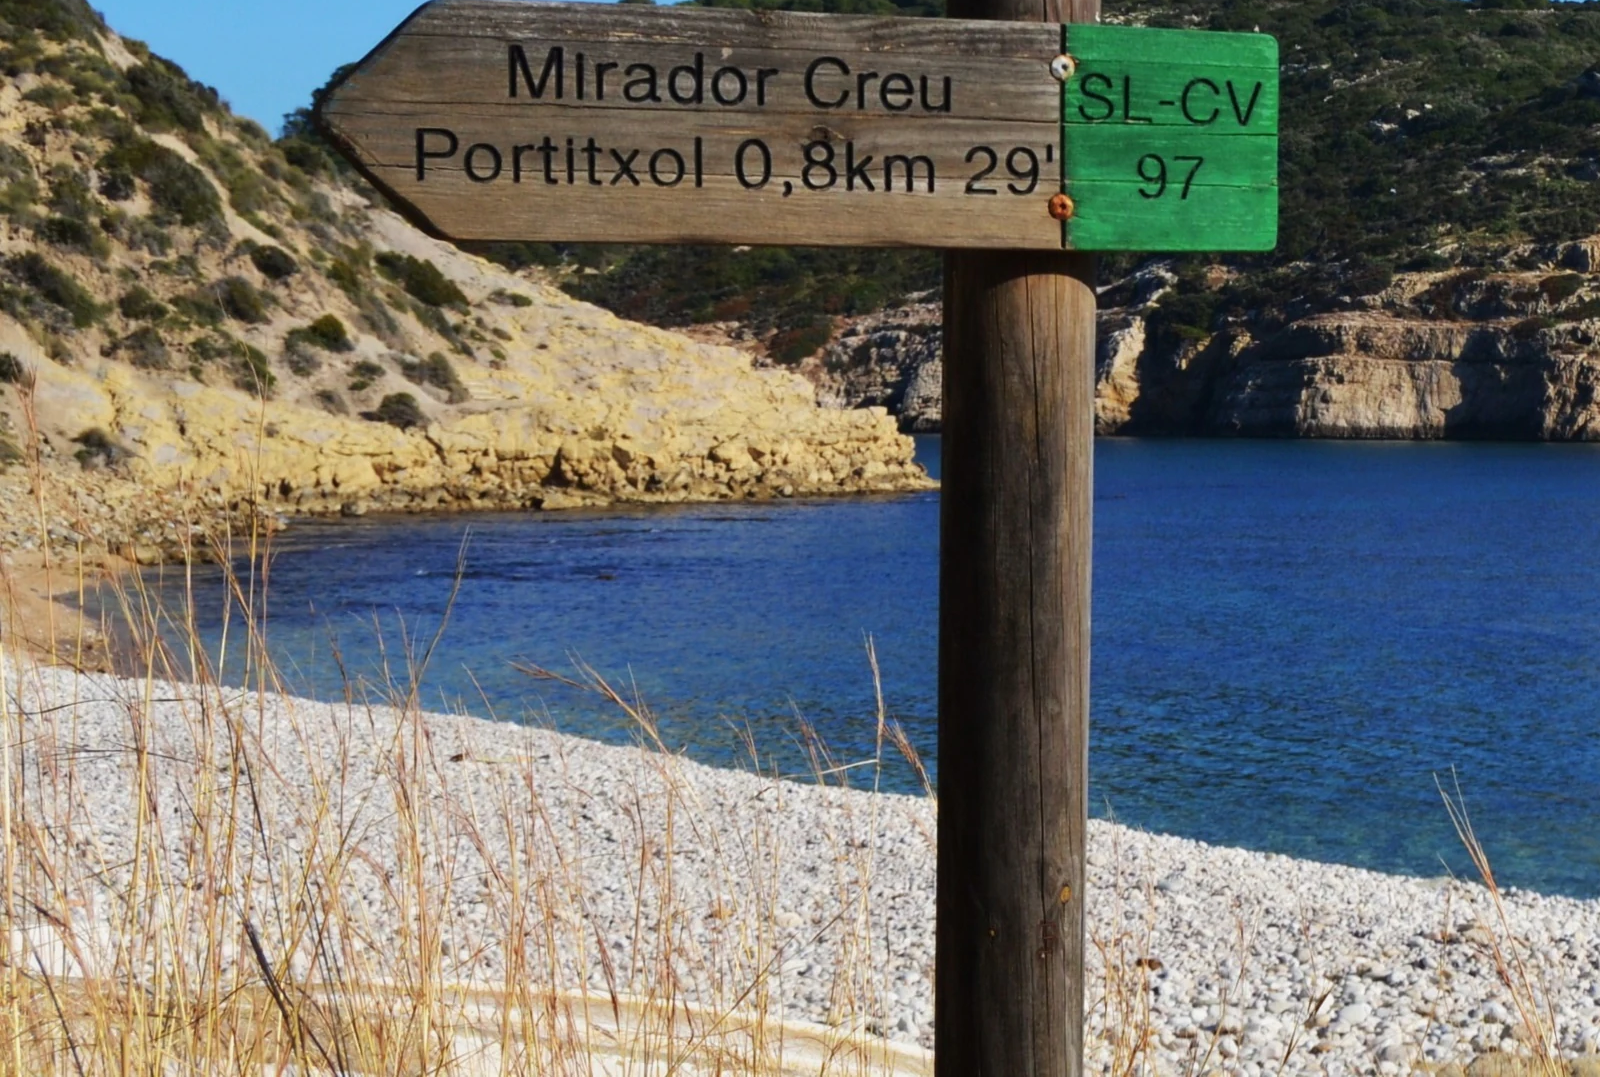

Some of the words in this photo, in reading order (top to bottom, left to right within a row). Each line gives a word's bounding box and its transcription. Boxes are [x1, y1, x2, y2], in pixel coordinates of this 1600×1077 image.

[506, 43, 778, 107] Mirador
[803, 56, 953, 114] Creu
[1077, 74, 1263, 127] SL-CV
[415, 127, 703, 189] Portitxol
[733, 138, 937, 198] 0,8km
[965, 143, 1055, 196] 29'
[1137, 154, 1205, 201] 97
